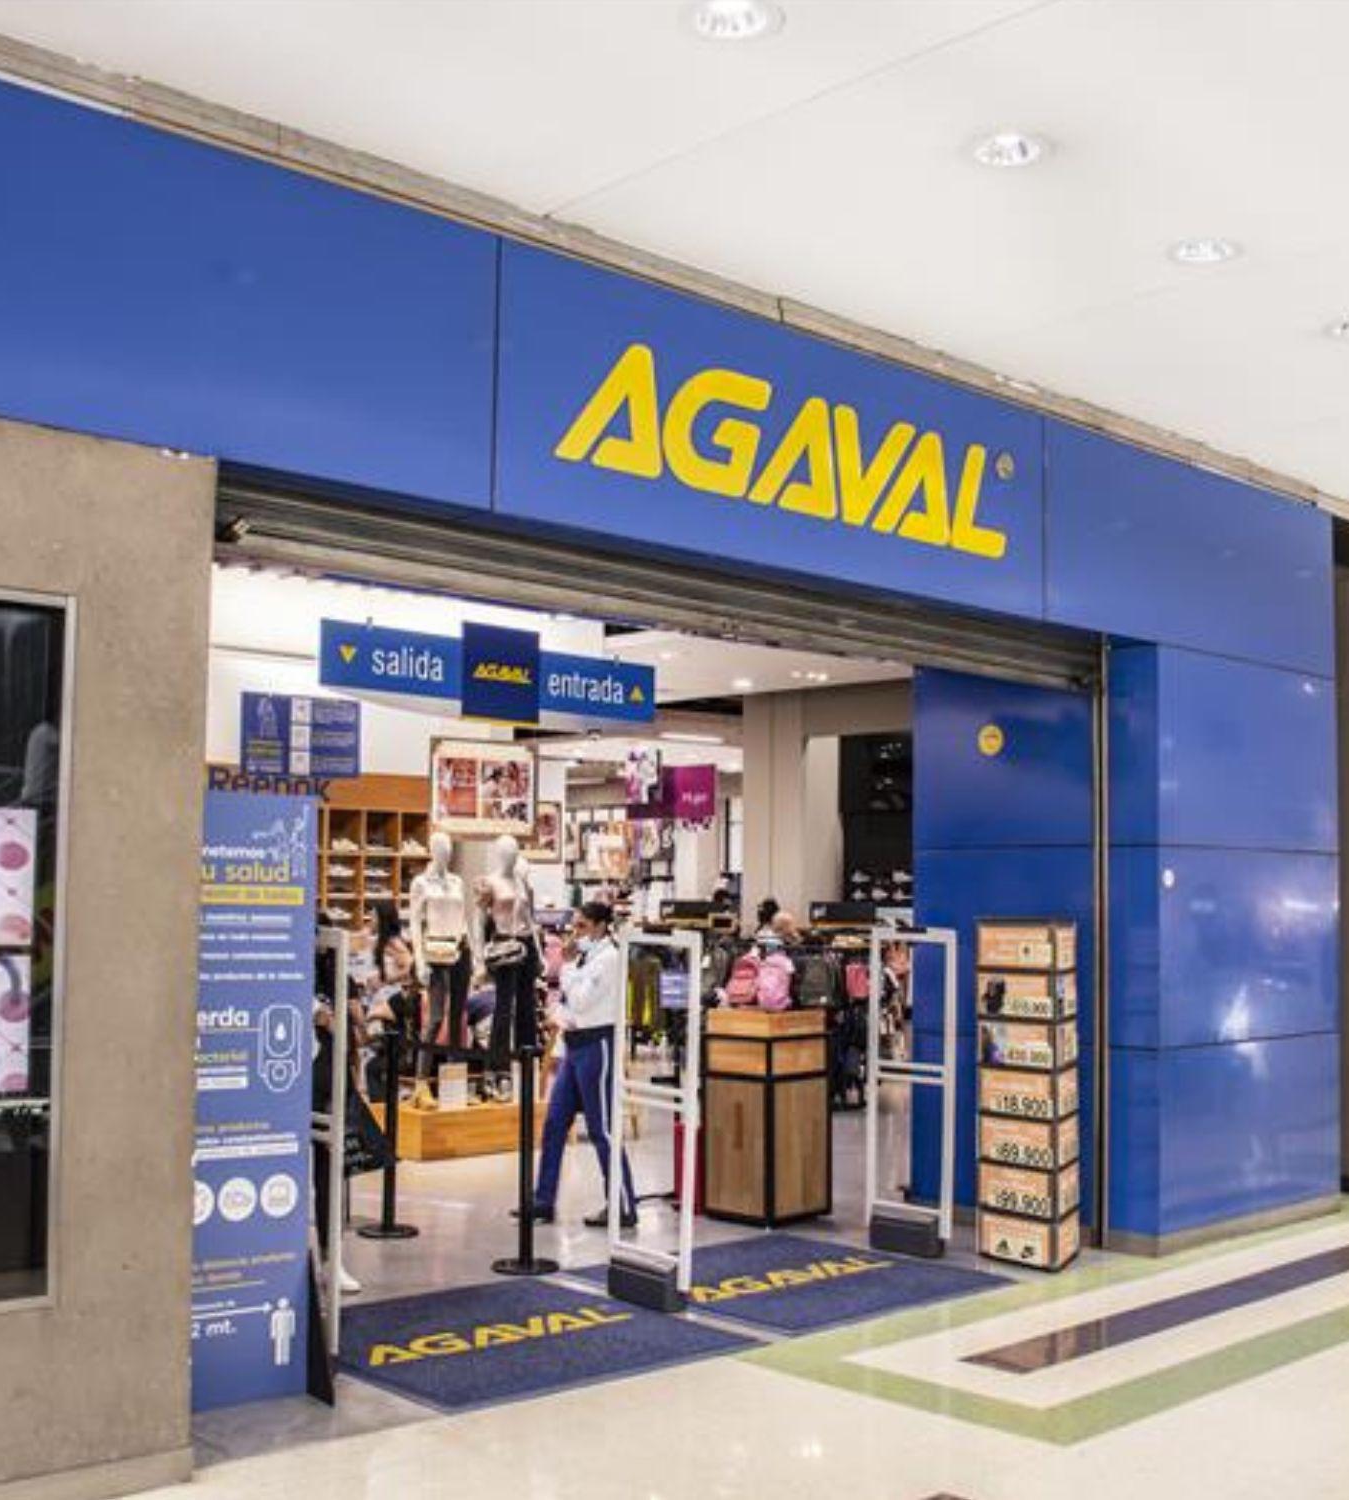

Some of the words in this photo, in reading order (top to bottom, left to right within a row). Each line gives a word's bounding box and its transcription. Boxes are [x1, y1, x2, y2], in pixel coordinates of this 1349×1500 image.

[555, 343, 1007, 559] AGAVAL
[371, 647, 444, 682] salida
[547, 672, 624, 704] entrada
[225, 859, 291, 883] salud
[692, 1257, 894, 1303] AGAVAL
[369, 1307, 633, 1366] AGAVAL
